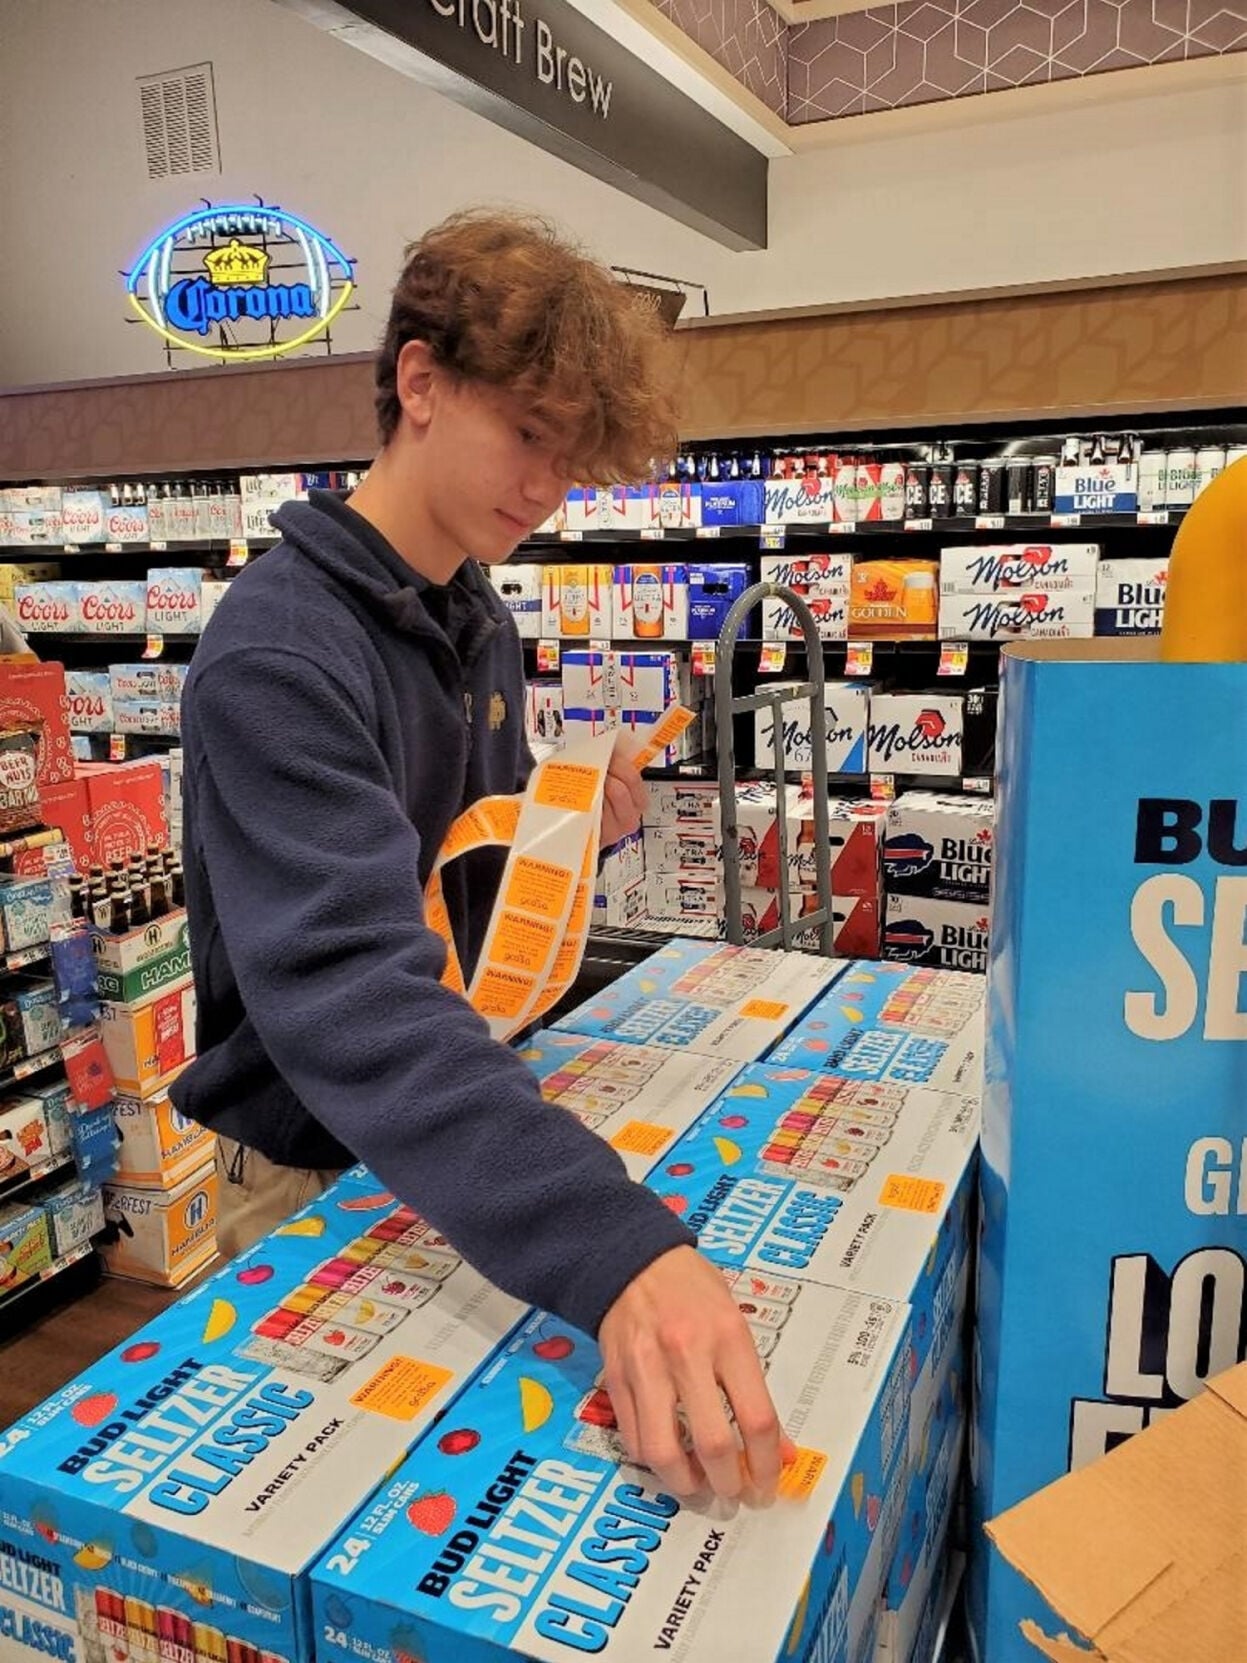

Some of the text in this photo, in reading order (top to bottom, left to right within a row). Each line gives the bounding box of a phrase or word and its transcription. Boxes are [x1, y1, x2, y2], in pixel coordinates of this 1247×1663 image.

[430, 0, 613, 120] raft Brew
[165, 276, 315, 336] Corona
[954, 484, 973, 504] ICE
[1075, 478, 1116, 493] Blue
[765, 485, 834, 518] Molson
[1073, 494, 1116, 509] LIGHT
[62, 506, 99, 525] Coors
[109, 515, 144, 533] Coors
[768, 561, 843, 586] Molson
[966, 554, 1068, 591] Molson
[147, 584, 197, 610] Coors
[1118, 583, 1167, 605] Blu
[18, 596, 70, 621] Coors
[81, 595, 136, 621] Coors
[154, 611, 188, 622] LIGHT
[768, 606, 844, 629] Moson
[851, 606, 907, 619] GOLDEN
[963, 602, 1064, 639] Molson
[1116, 609, 1164, 628] LIGH
[31, 622, 59, 631] LIGHT
[96, 622, 124, 631] LIGHT
[64, 695, 104, 716] ors
[71, 716, 93, 726] GHT
[761, 720, 852, 755] Molon
[869, 722, 962, 761] Molson
[1, 756, 29, 771] BEER
[5, 767, 32, 786] NUTS
[519, 859, 570, 878] WARNING!
[504, 914, 554, 933] WARNING!
[941, 947, 987, 969] LIGH
[486, 969, 533, 986] WARNING!
[687, 1173, 739, 1233] UD LIGHT
[697, 1177, 790, 1257] SELTZER
[757, 1190, 844, 1269] CLASSIC
[840, 1235, 865, 1270] VARIETY
[860, 1212, 878, 1238] PACK
[354, 1358, 403, 1403] WARNING!
[57, 1357, 204, 1476] BUD LIGHT
[82, 1364, 260, 1493] SELTZER
[149, 1381, 315, 1516] CLASSIC
[245, 1453, 307, 1514] VARIETY
[306, 1417, 345, 1454] PACK
[801, 1455, 824, 1492] WARN
[360, 1479, 411, 1531] 12 FL. OZ.
[372, 1481, 420, 1536] SLIM CANS
[415, 1530, 480, 1600] BUD
[465, 1449, 538, 1530] LIGHT
[448, 1457, 608, 1624] SELTZER
[0, 1543, 60, 1577] UD LIGHT
[326, 1537, 372, 1576] 24
[534, 1483, 680, 1654] CLASSIC
[0, 1554, 66, 1612] ELTZER
[654, 1527, 726, 1652] VARIETY PACK
[98, 1616, 126, 1638] SELTZE
[324, 1625, 348, 1649] 24
[160, 1641, 195, 1663] SELTZE
